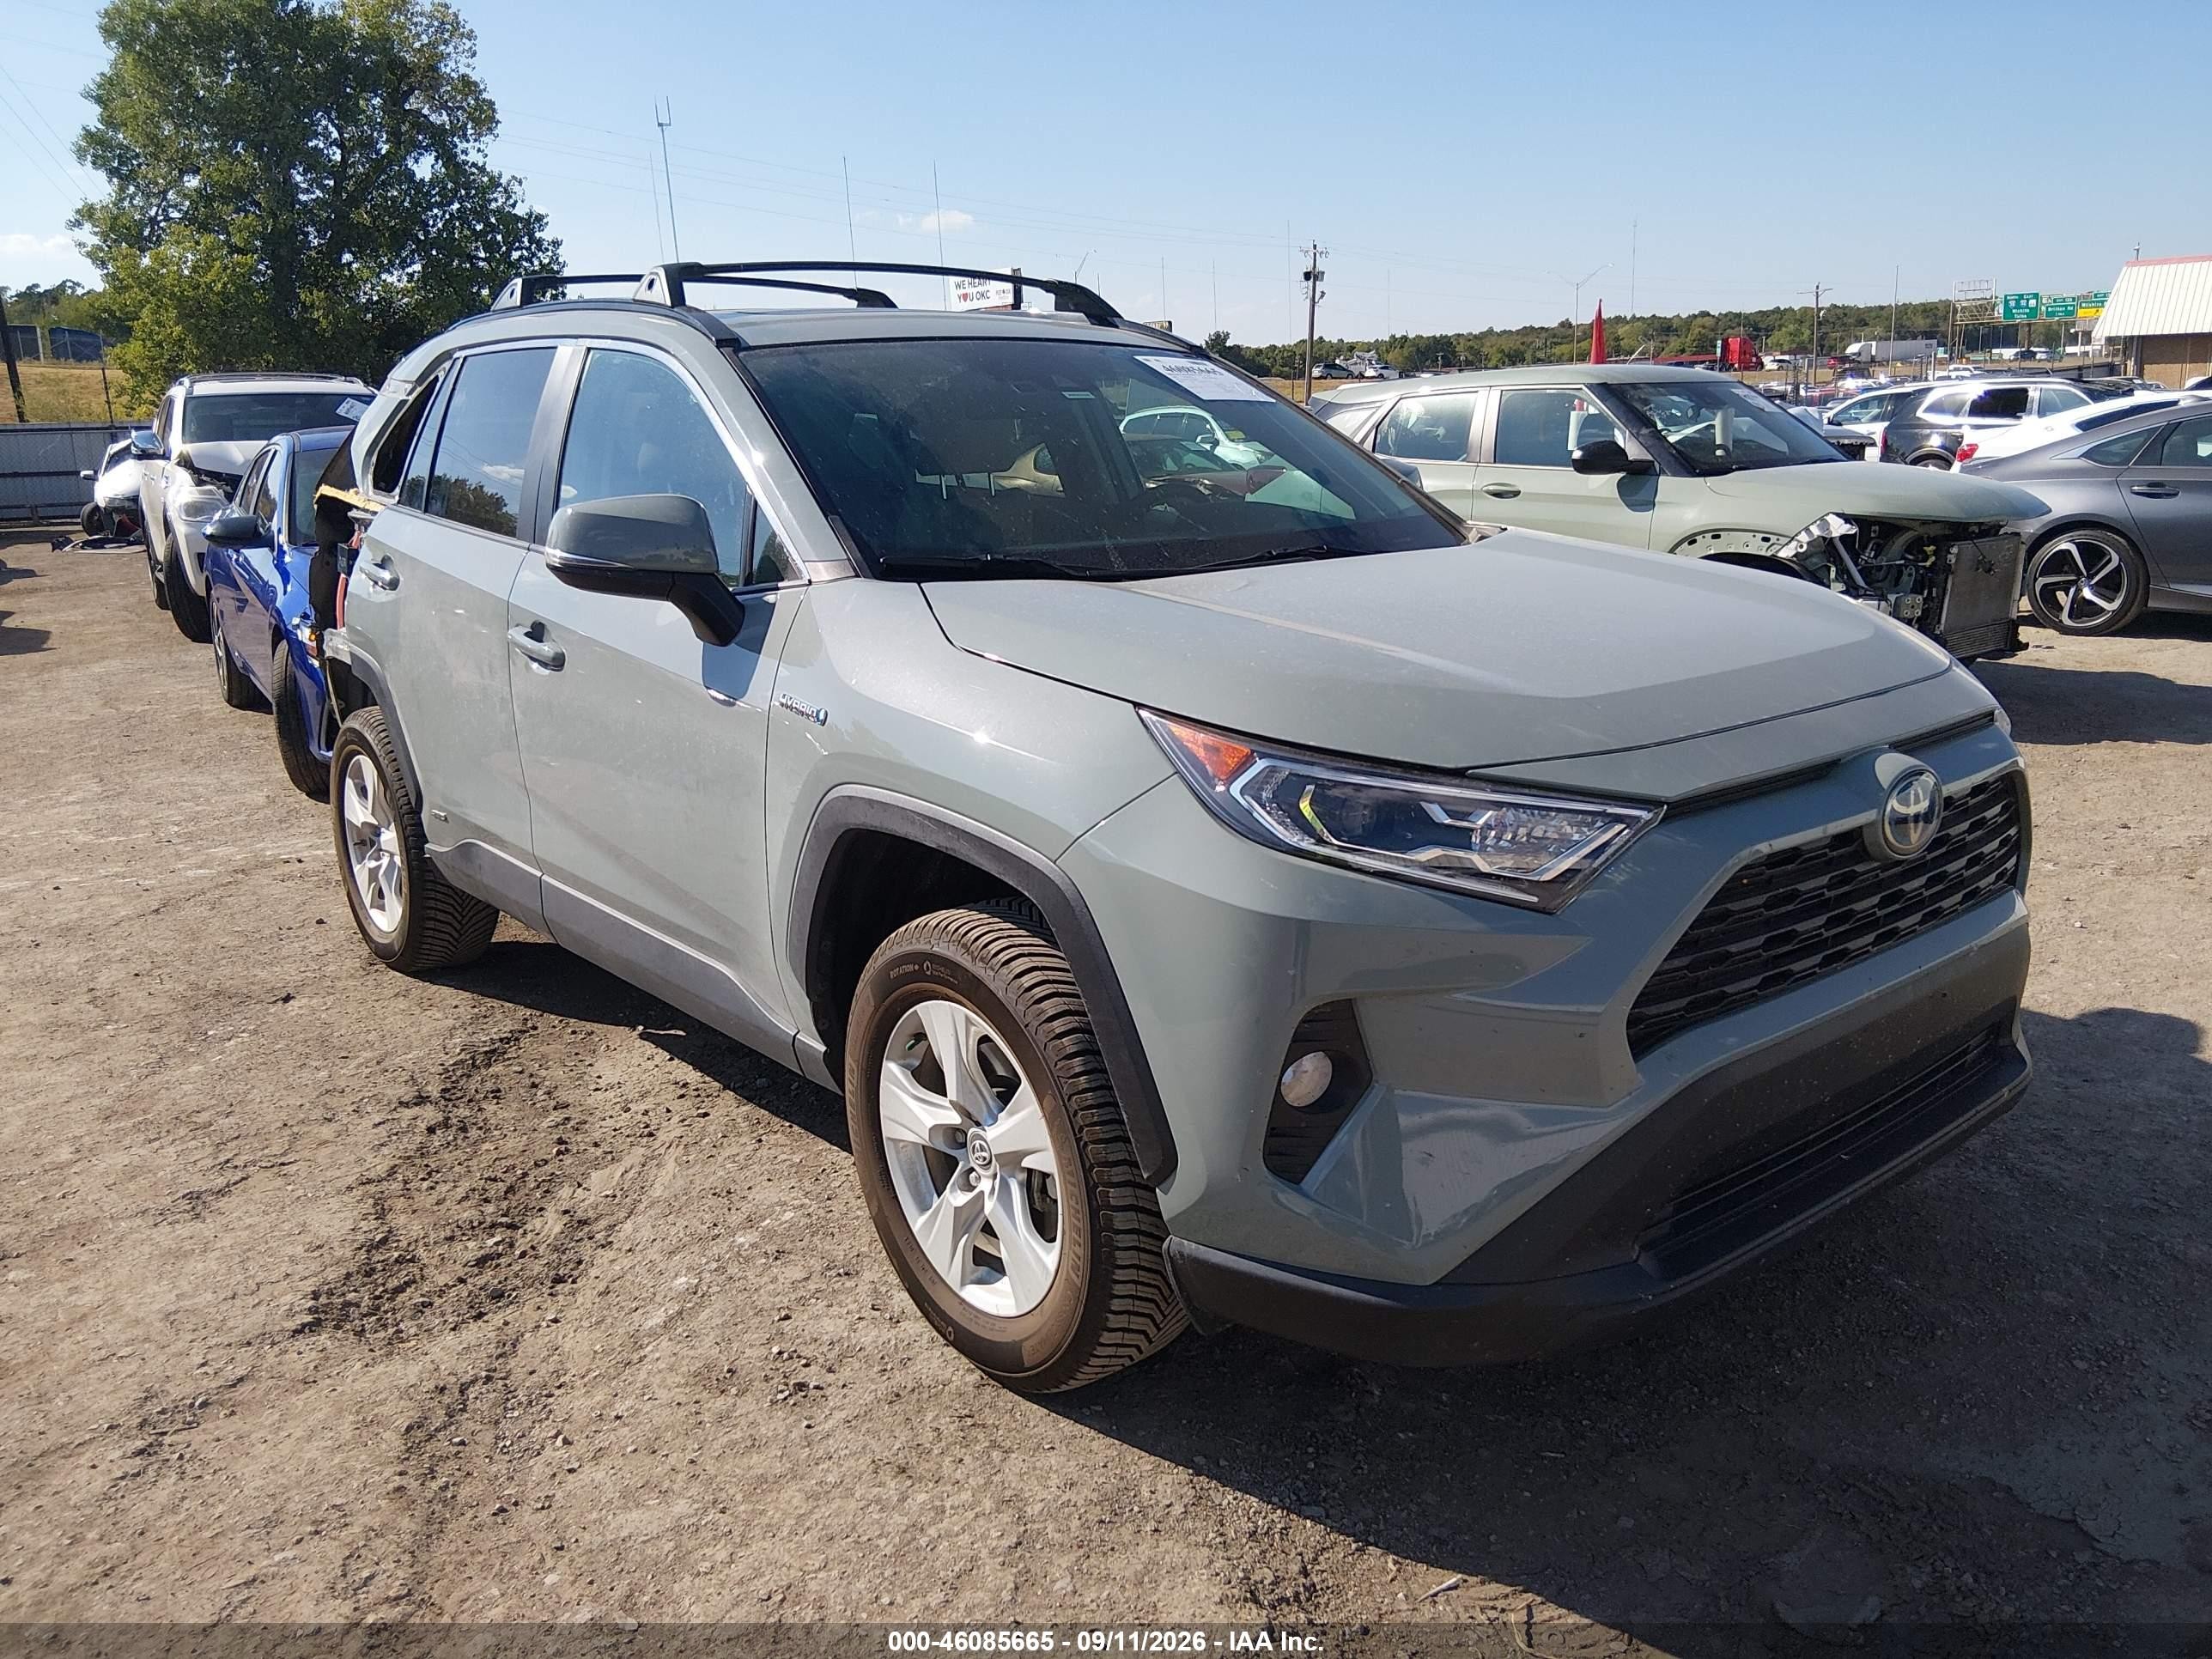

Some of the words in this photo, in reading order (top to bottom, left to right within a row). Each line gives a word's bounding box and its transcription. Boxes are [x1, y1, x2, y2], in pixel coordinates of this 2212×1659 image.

[955, 280, 966, 290] WE
[975, 289, 991, 301] OKC
[890, 963, 915, 979] ROTATION
